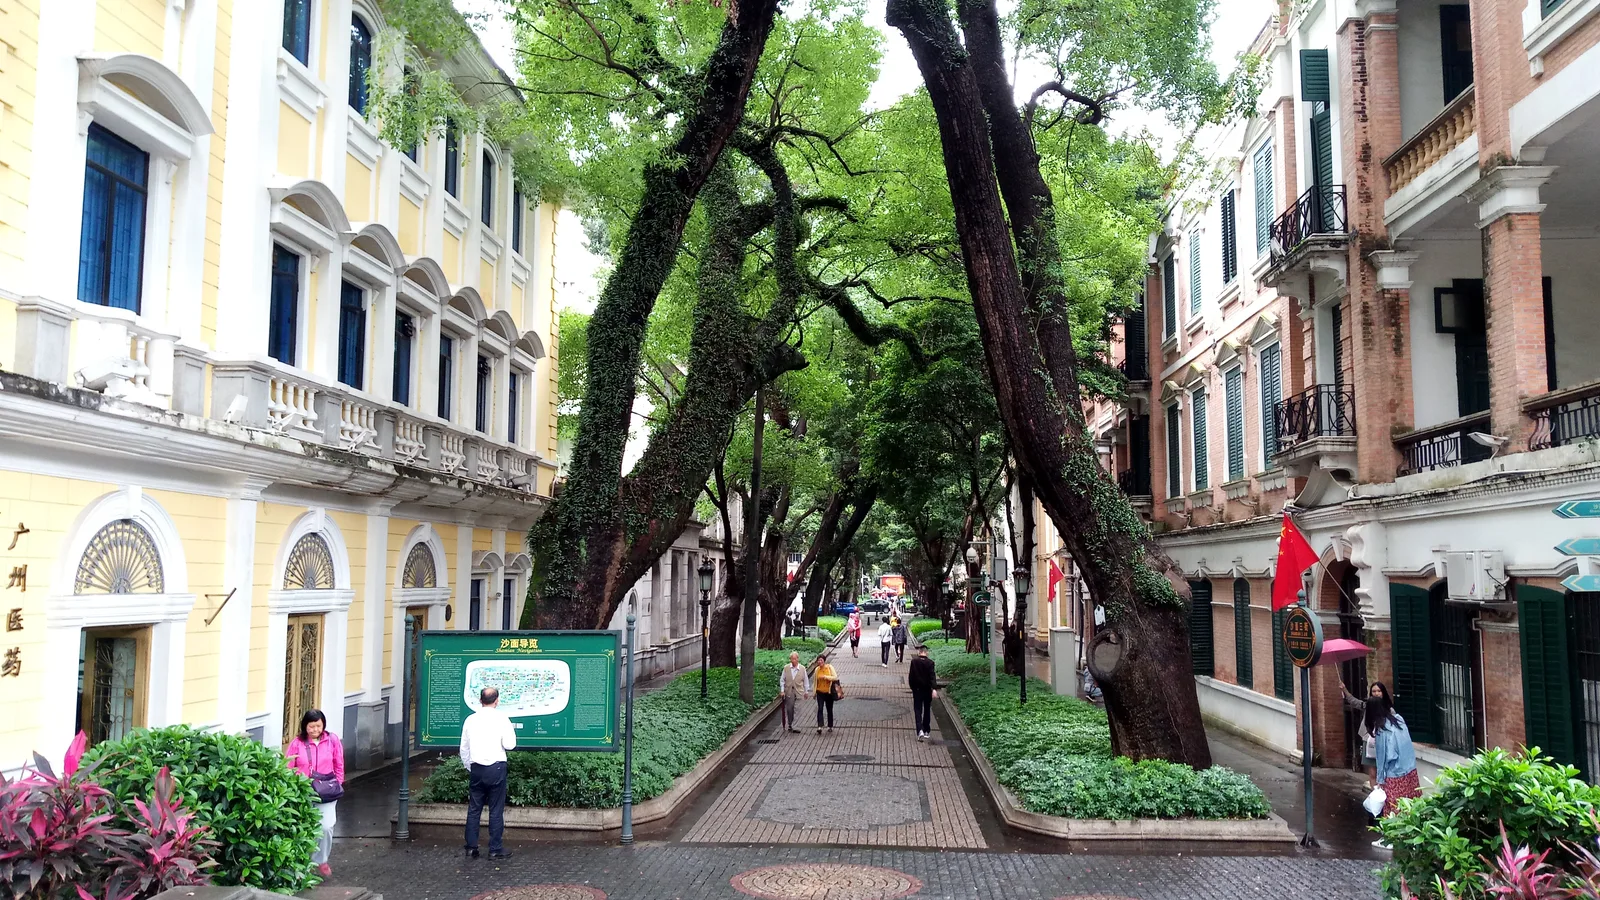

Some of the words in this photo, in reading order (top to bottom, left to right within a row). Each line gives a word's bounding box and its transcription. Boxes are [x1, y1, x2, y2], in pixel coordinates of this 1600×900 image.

[1, 522, 30, 678] 广州医药
[500, 638, 539, 648] 沙面导览
